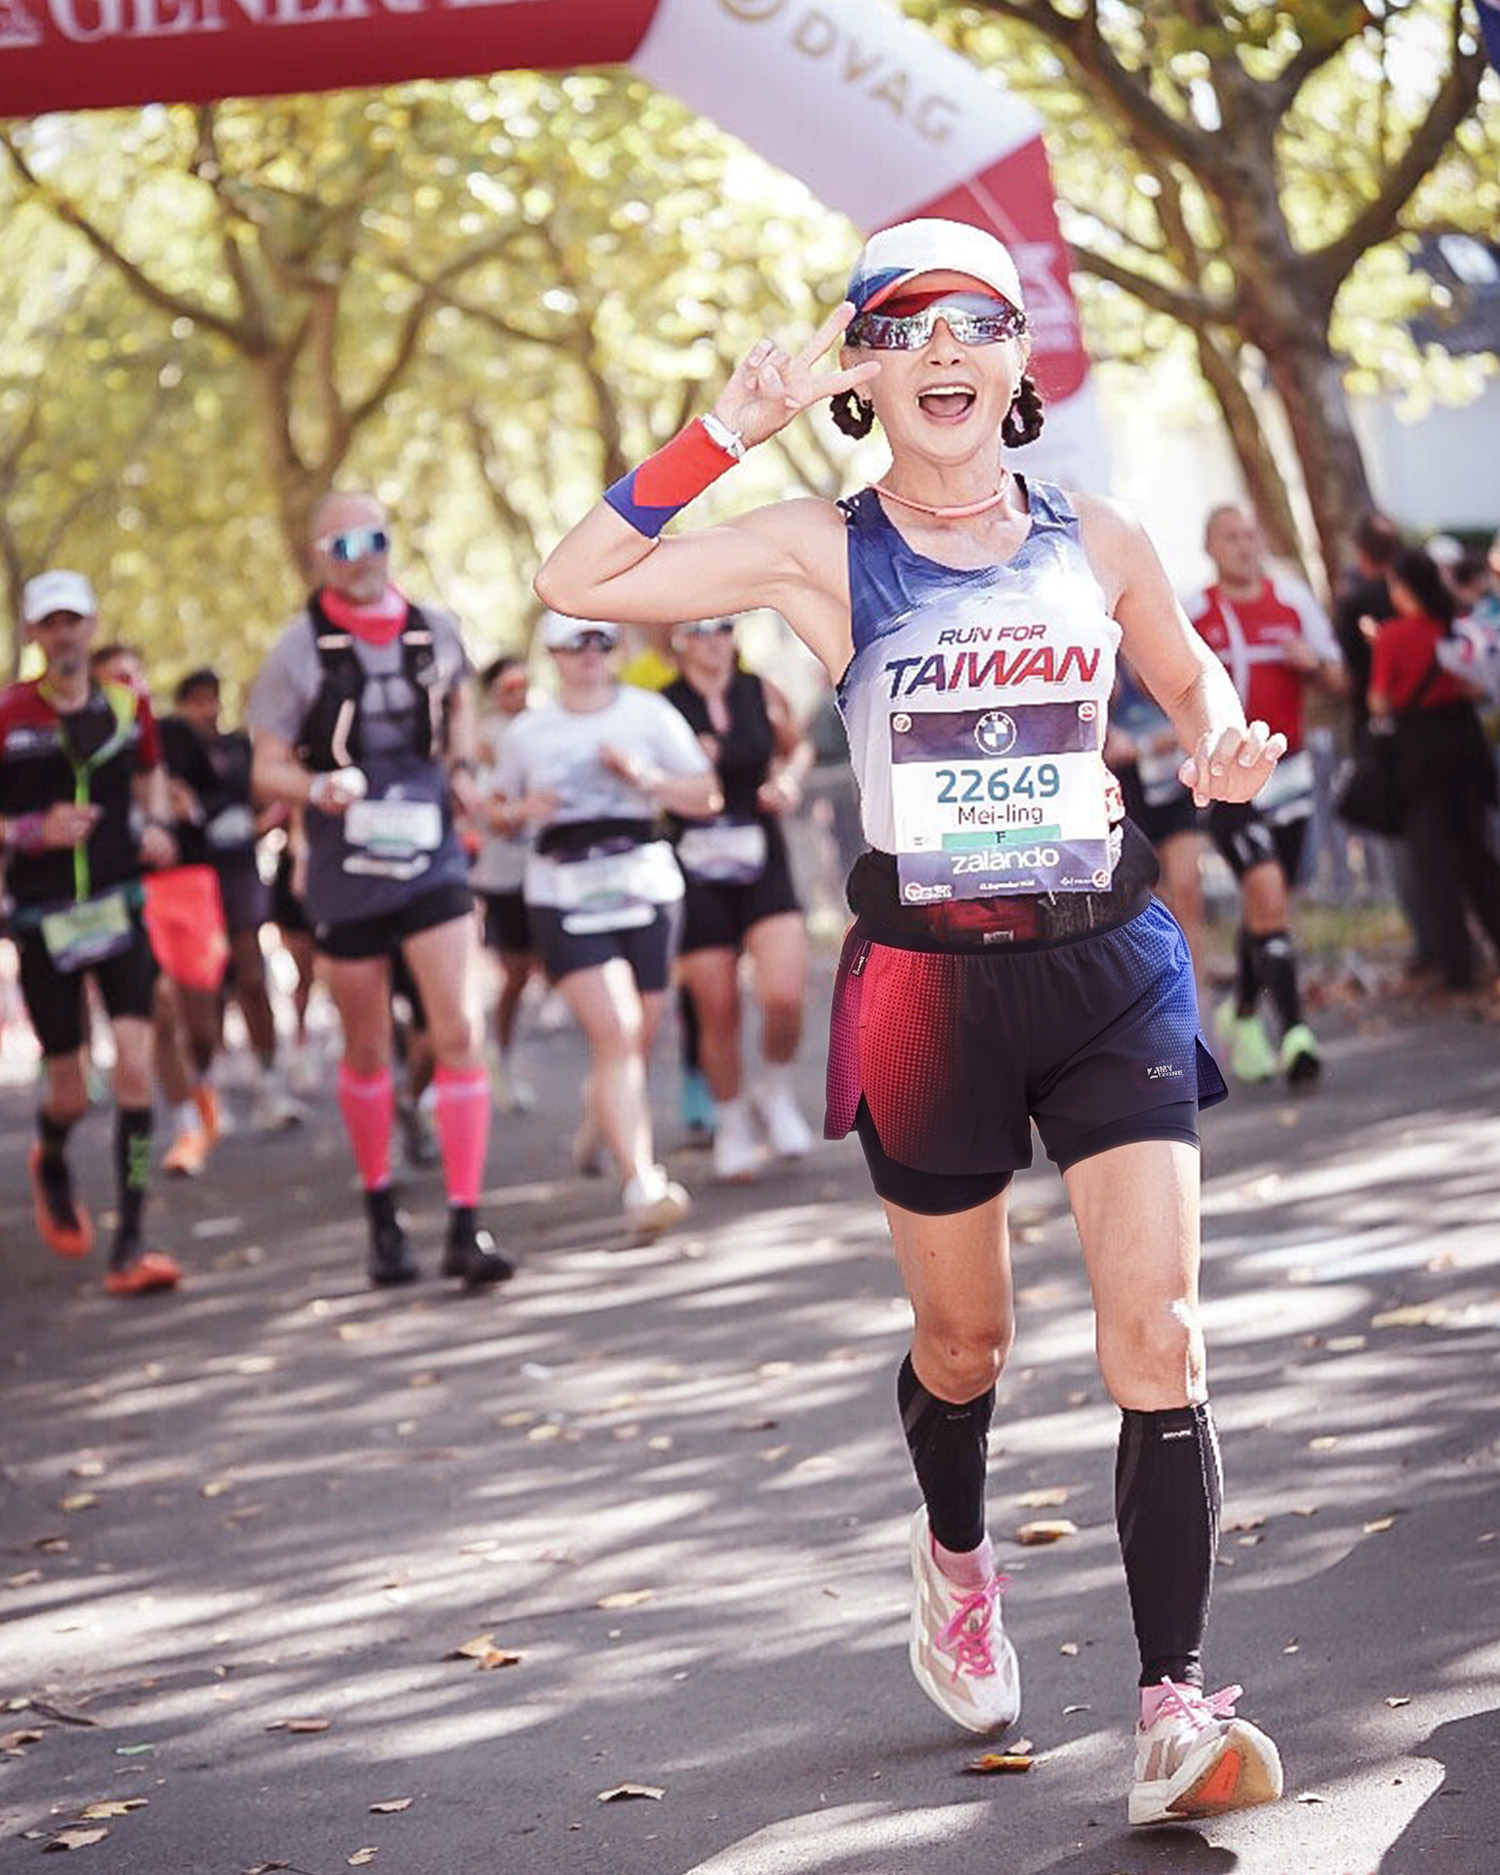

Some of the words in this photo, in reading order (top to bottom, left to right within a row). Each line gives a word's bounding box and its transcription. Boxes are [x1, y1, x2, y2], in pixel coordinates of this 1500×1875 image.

[790, 9, 961, 142] DVAG
[938, 627, 992, 645] RUN
[997, 624, 1047, 641] FOR
[885, 646, 1100, 698] TAIWAN
[936, 763, 1060, 803] 22649
[958, 804, 1043, 824] Mei-ling
[995, 831, 1007, 844] F
[951, 846, 1060, 875] zalando
